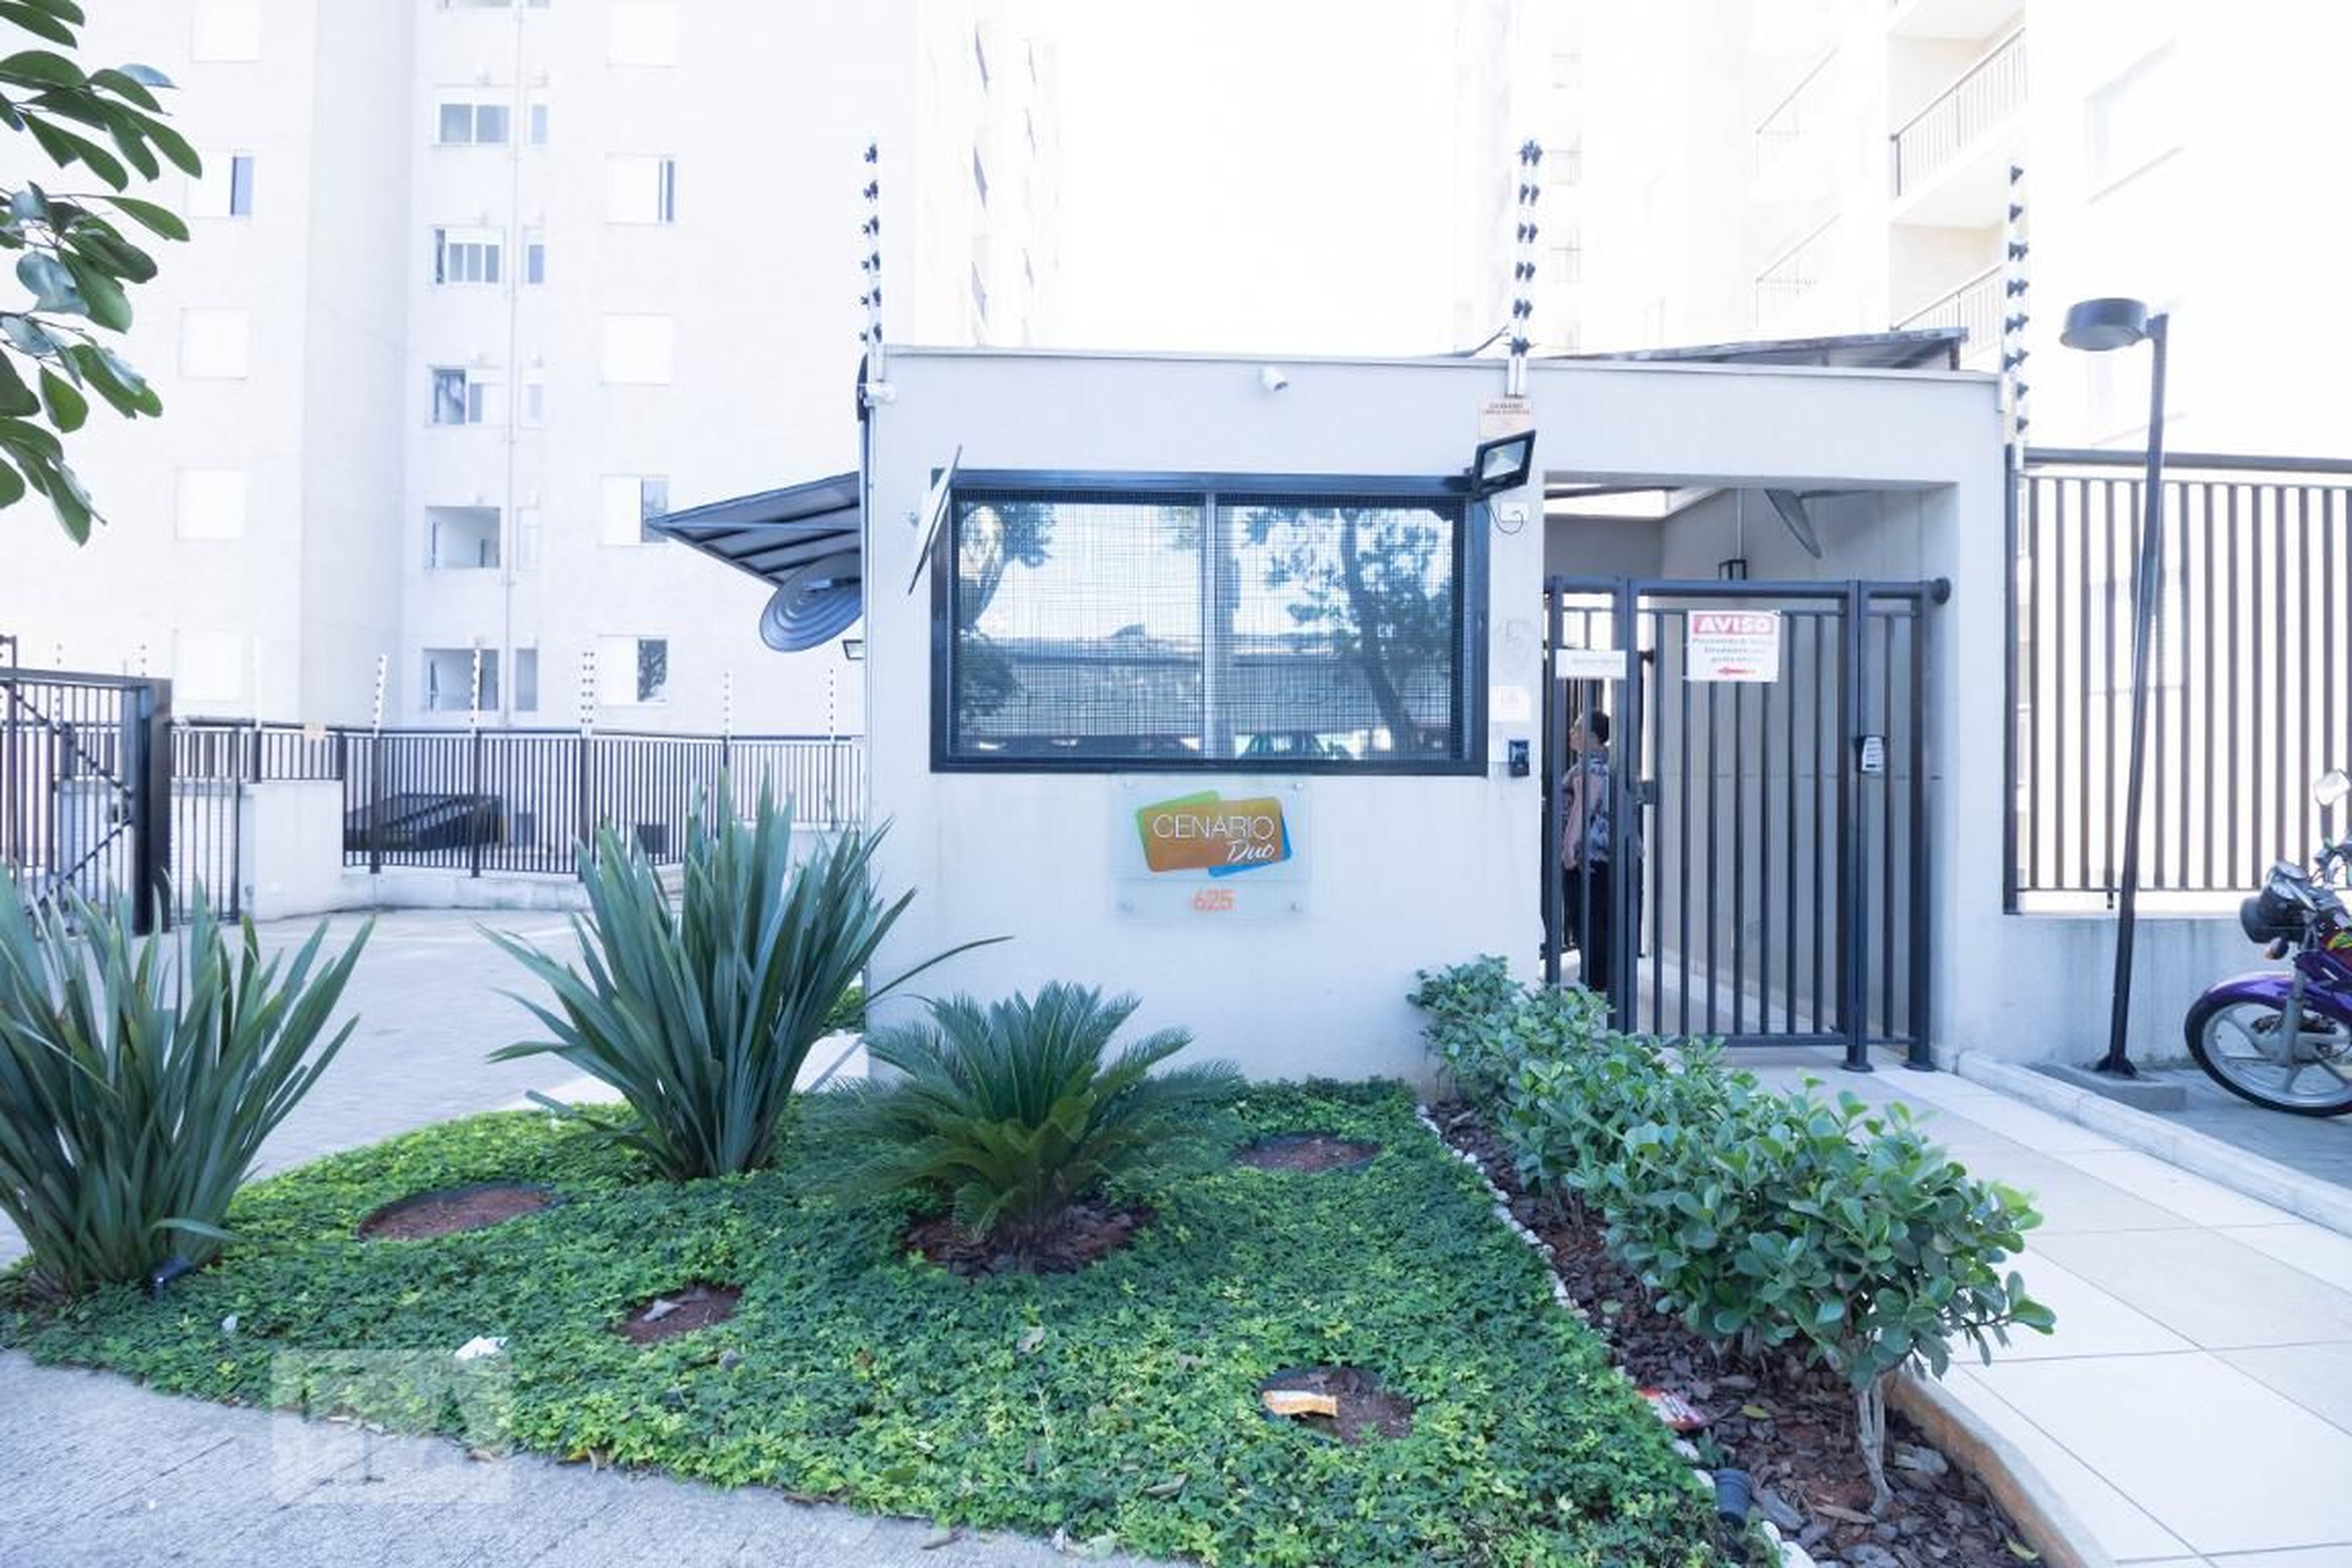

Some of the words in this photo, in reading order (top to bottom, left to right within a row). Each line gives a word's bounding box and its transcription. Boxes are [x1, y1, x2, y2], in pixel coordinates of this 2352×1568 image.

[1698, 616, 1770, 633] AVISO
[1226, 840, 1275, 862] Duo
[1193, 889, 1235, 912] 625
